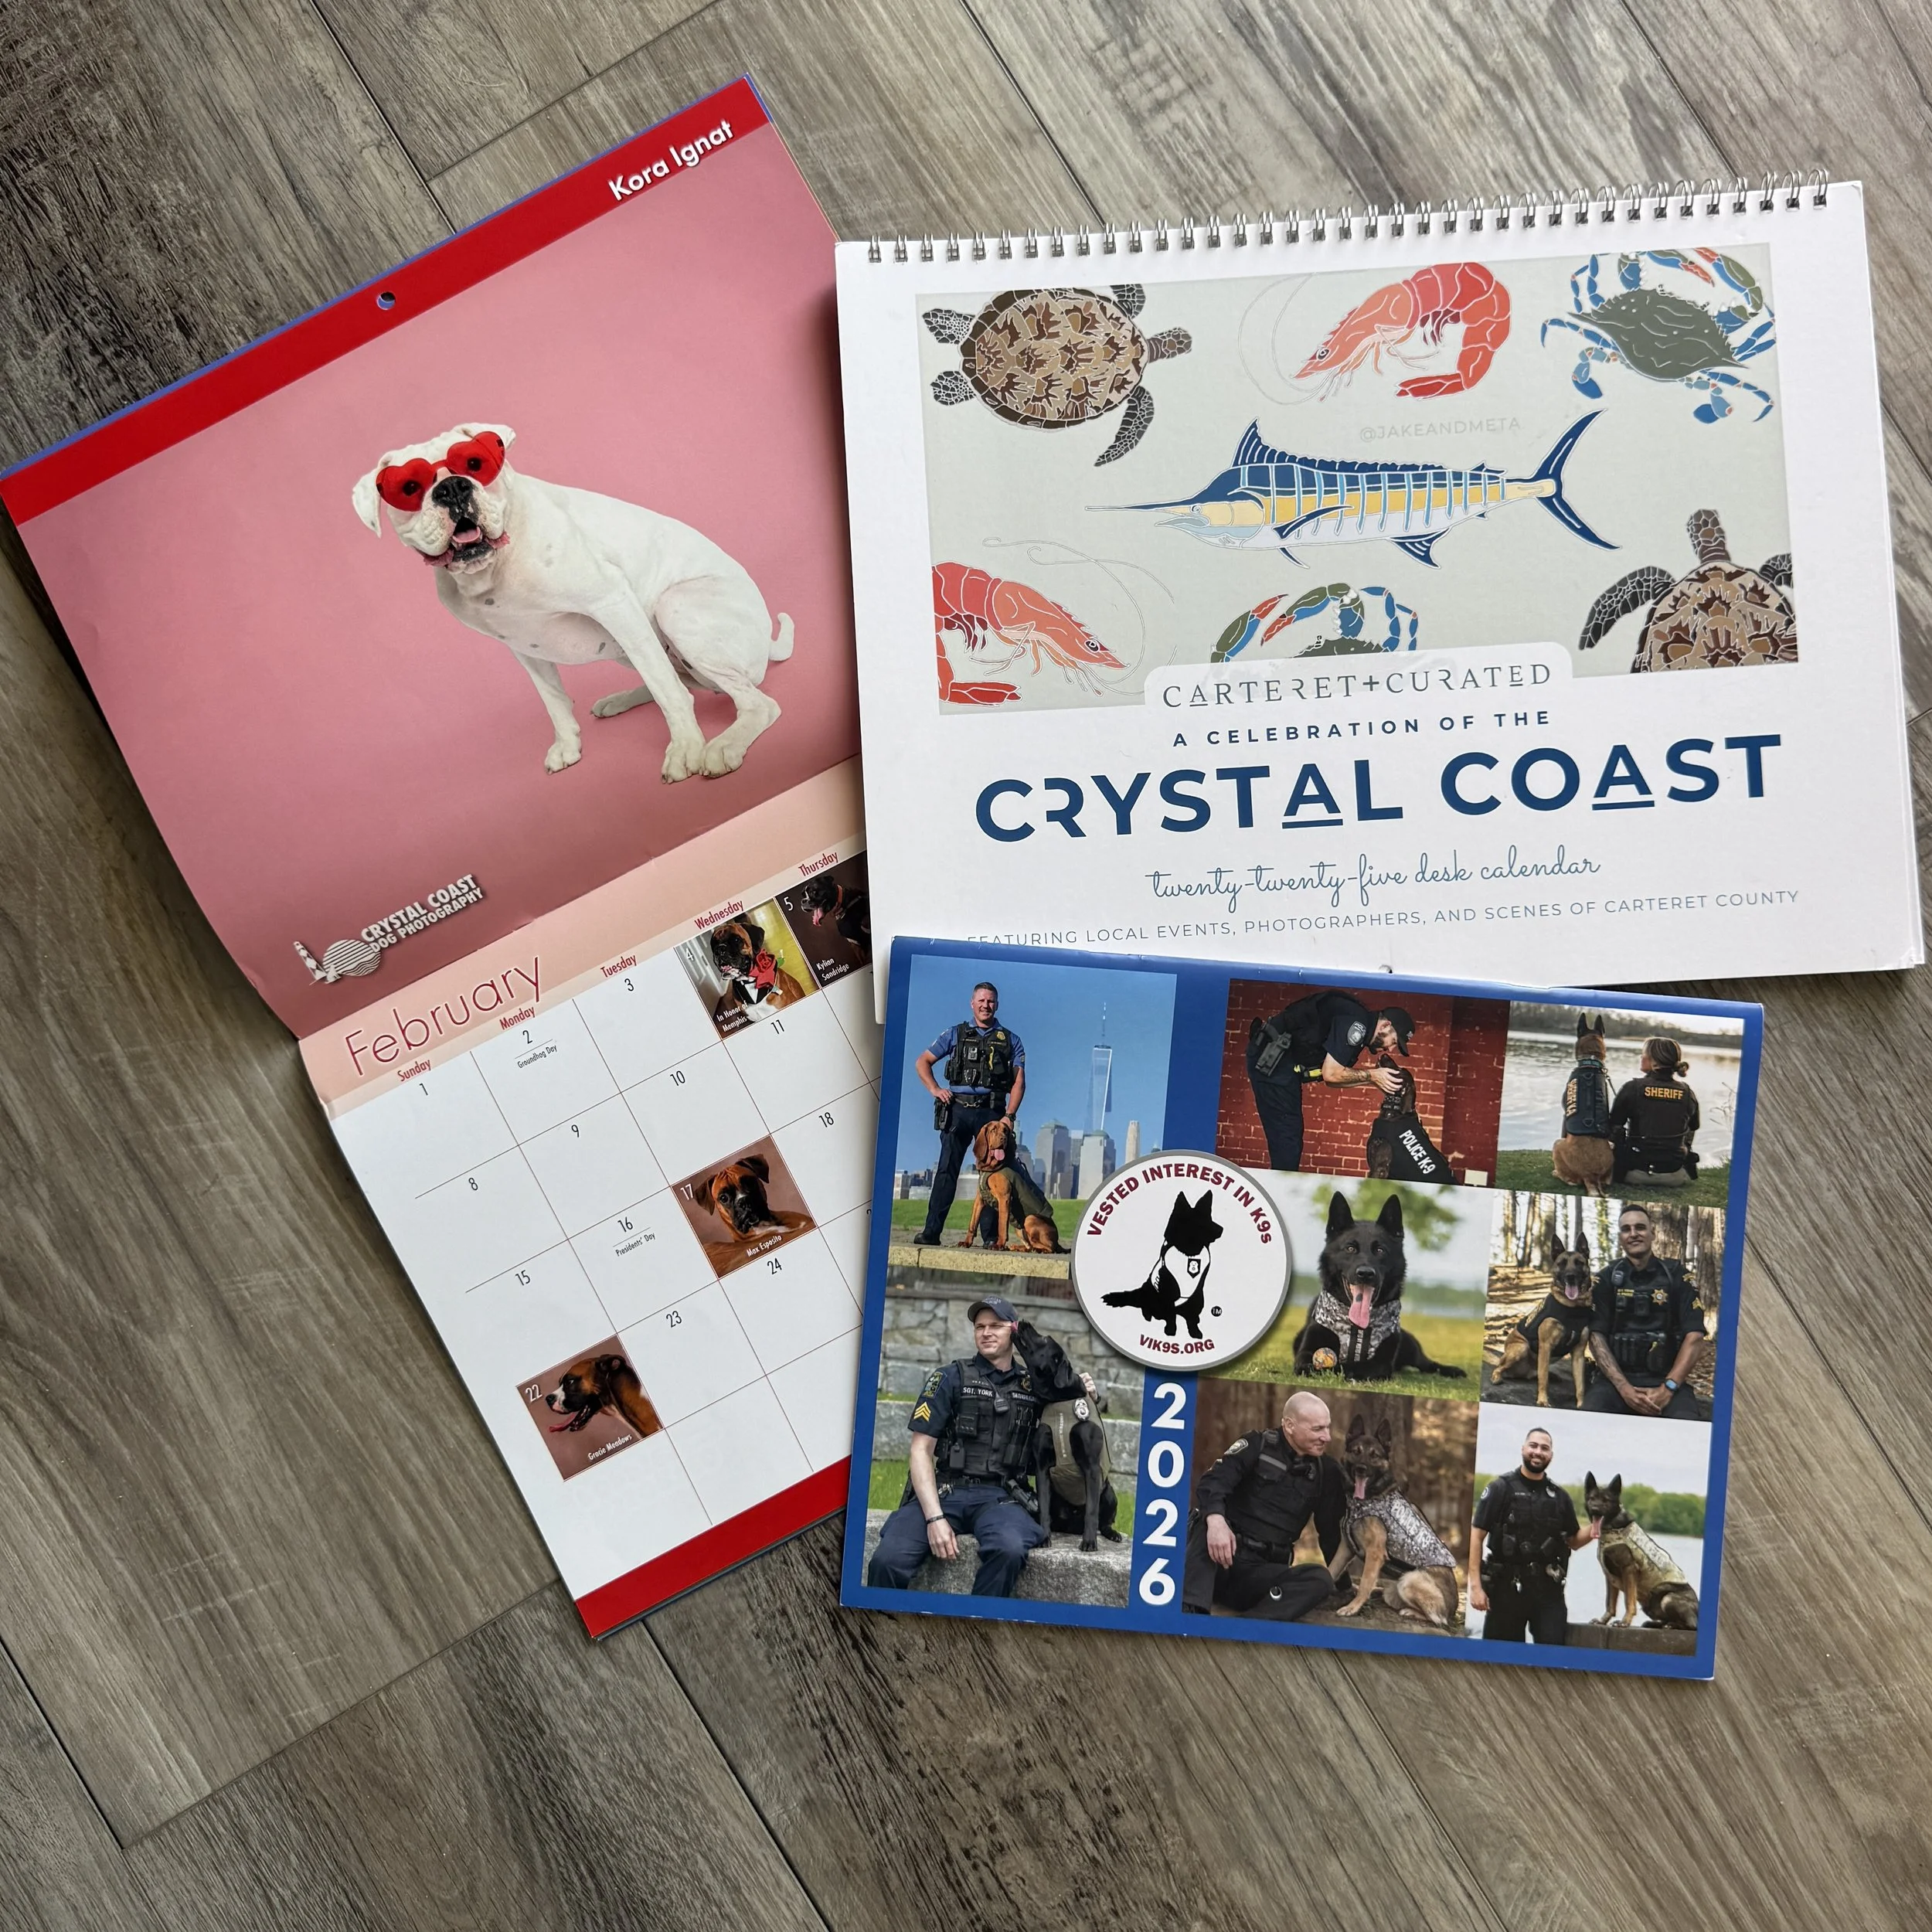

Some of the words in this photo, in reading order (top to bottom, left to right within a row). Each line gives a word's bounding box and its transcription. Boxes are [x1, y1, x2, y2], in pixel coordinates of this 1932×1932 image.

[607, 158, 670, 201] Kora
[668, 118, 734, 168] Ignat
[1360, 417, 1522, 443] @JAKEANDMETA
[1172, 733, 1188, 747] A
[1206, 718, 1420, 745] CELEBRATION
[1440, 715, 1475, 731] OF
[1494, 710, 1550, 727] THE
[975, 760, 1404, 843] CRYSTAL
[1439, 733, 1782, 818] COAST
[798, 850, 838, 877] Thursday
[1145, 853, 1407, 913] twenty-twenty-five
[1414, 849, 1472, 884] desk
[1480, 844, 1601, 878] calendar
[361, 901, 427, 943] CRYSTAL
[427, 873, 478, 908] COAST
[784, 896, 794, 911] 5
[369, 933, 398, 953] DOG
[399, 887, 485, 939] PHOTOGRAPHY
[694, 899, 745, 930] Wednesday
[1086, 927, 1149, 943] LOCAL
[1157, 921, 1236, 939] EVENTS,
[1244, 911, 1426, 934] PHOTOGRAPHERS,
[1434, 908, 1477, 923] AND
[1484, 903, 1562, 920] SCENES
[1570, 901, 1597, 915] OF
[1604, 895, 1708, 913] CARTERET
[1715, 890, 1799, 907] COUNTY
[685, 947, 694, 961] 4
[600, 953, 638, 978] Tuesday
[816, 958, 835, 971] Kylian
[821, 964, 849, 981] Sandridge
[624, 978, 634, 992] 3
[345, 956, 540, 1077] February
[498, 1006, 536, 1030] Monday
[723, 1006, 741, 1019] Honor
[742, 1000, 748, 1009] of
[722, 1015, 747, 1032] Memphis
[770, 1019, 785, 1035] 11
[522, 1030, 533, 1044] 2
[517, 1051, 546, 1069] Groundhog
[546, 1043, 558, 1056] Day
[397, 1058, 431, 1082] Sunday
[669, 1070, 686, 1087] 10
[419, 1083, 429, 1096] 1
[1644, 1087, 1684, 1100] SHERIFF
[818, 1112, 835, 1128] 18
[570, 1124, 580, 1138] 9
[1399, 1129, 1427, 1162] POLICE
[468, 1177, 478, 1191] 8
[680, 1183, 696, 1201] 17
[1087, 1176, 1140, 1236] VESTED
[1141, 1163, 1235, 1191] INTEREST
[1233, 1185, 1254, 1208] IN
[1250, 1207, 1272, 1244] K9s
[617, 1216, 634, 1233] 16
[645, 1231, 656, 1243] Day
[746, 1247, 760, 1257] Max
[759, 1235, 782, 1250] Esposito
[767, 1257, 782, 1275] 24
[515, 1270, 531, 1286] 15
[666, 1311, 682, 1328] 23
[1139, 1334, 1215, 1354] VIK9S.ORG
[526, 1384, 543, 1403] 22
[978, 1388, 993, 1397] YORK
[588, 1447, 607, 1461] Gracie
[606, 1434, 632, 1451] Meadows
[1138, 1382, 1187, 1606] 2026
